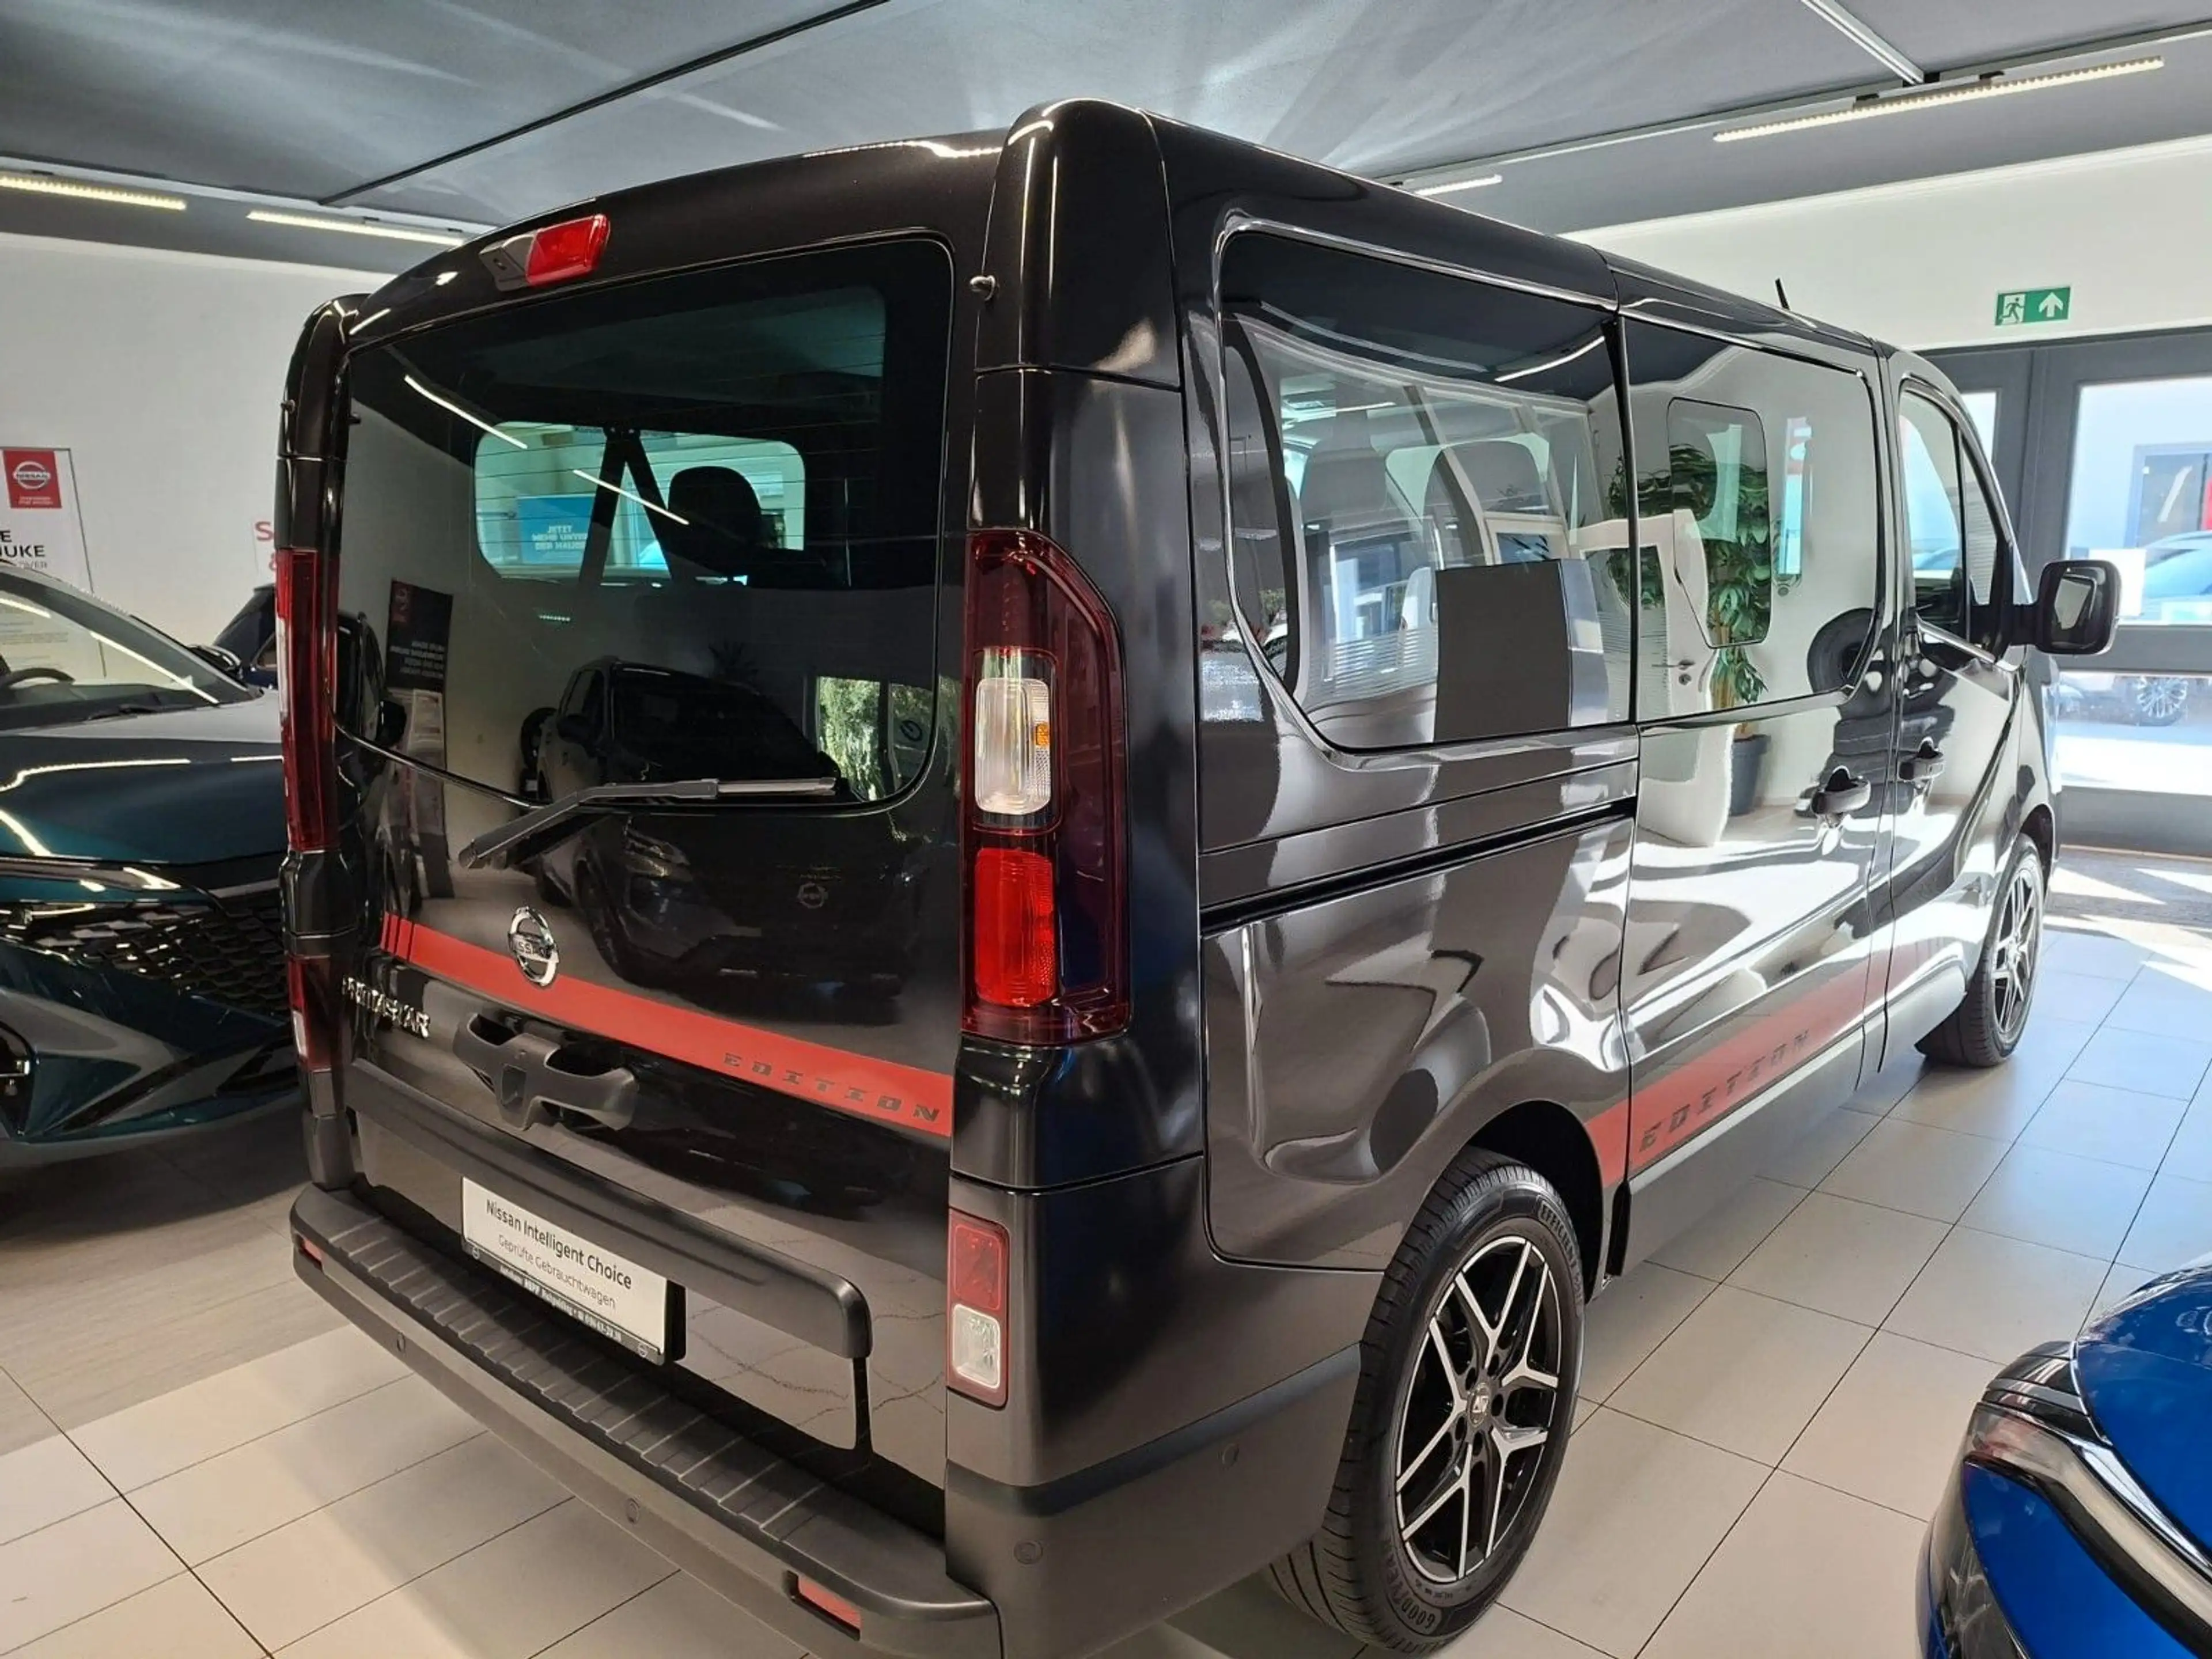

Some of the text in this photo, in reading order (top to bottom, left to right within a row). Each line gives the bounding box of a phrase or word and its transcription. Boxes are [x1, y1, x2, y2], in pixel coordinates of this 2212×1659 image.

[724, 1052, 940, 1123] EDITION
[1639, 1028, 1809, 1153] EDITION
[486, 1198, 632, 1290] Nissan Intelligent Choice
[535, 1256, 616, 1310] Gebrauchtwagen
